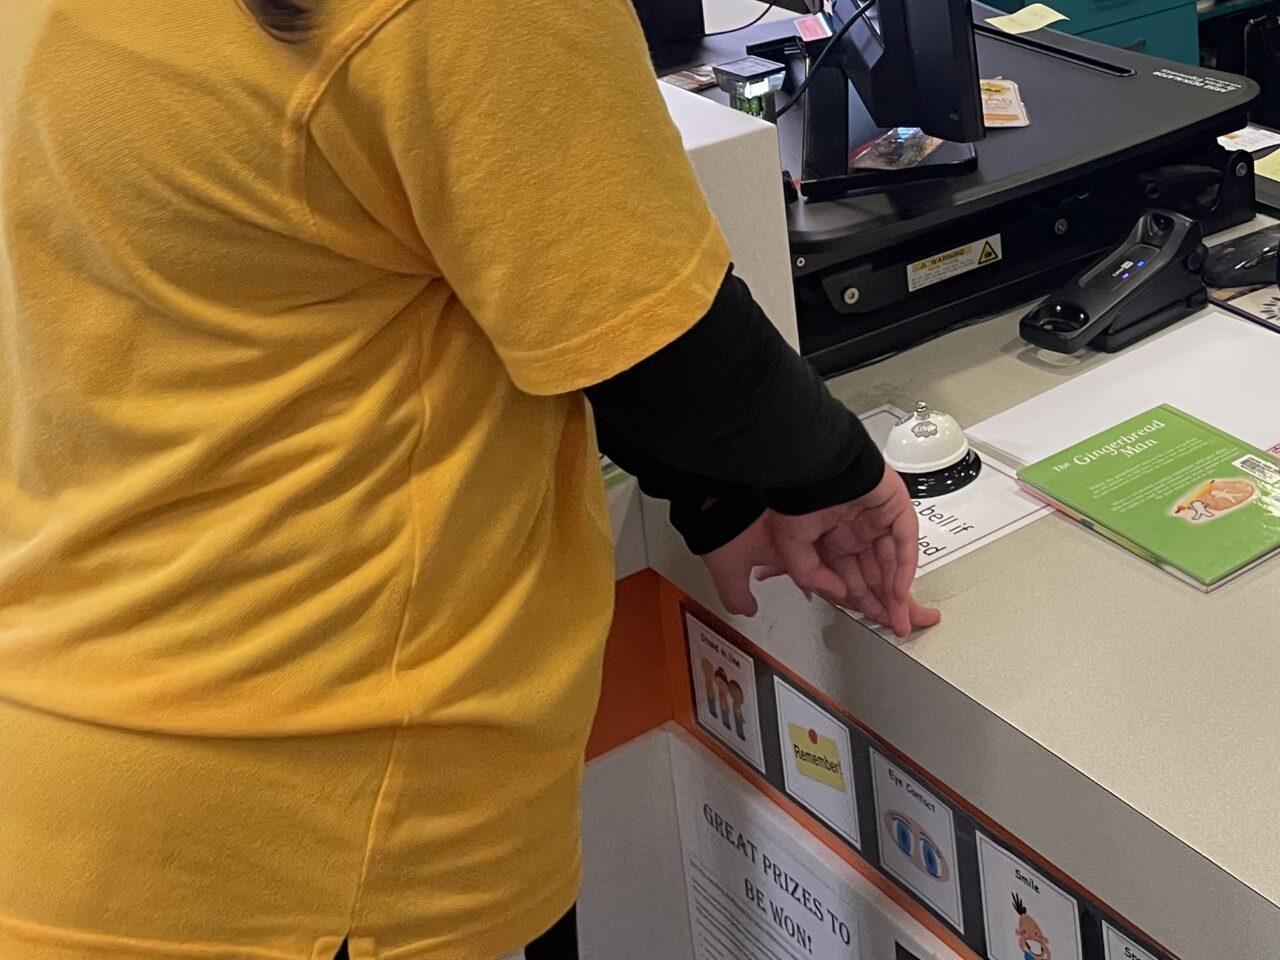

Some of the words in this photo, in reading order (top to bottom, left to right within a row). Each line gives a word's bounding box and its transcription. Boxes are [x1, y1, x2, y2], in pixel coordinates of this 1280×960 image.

[1052, 462, 1071, 472] The
[1073, 419, 1166, 466] Gingerbread
[1120, 438, 1159, 458] Man
[918, 504, 959, 527] bell
[948, 522, 975, 535] if
[793, 743, 843, 777] Remember!
[888, 768, 904, 788] Eye
[703, 803, 758, 863] GREAT
[762, 853, 824, 922] PRIZES
[827, 908, 851, 945] TO
[1015, 869, 1041, 894] Smile
[744, 877, 767, 915] BE
[769, 899, 814, 955] WON!
